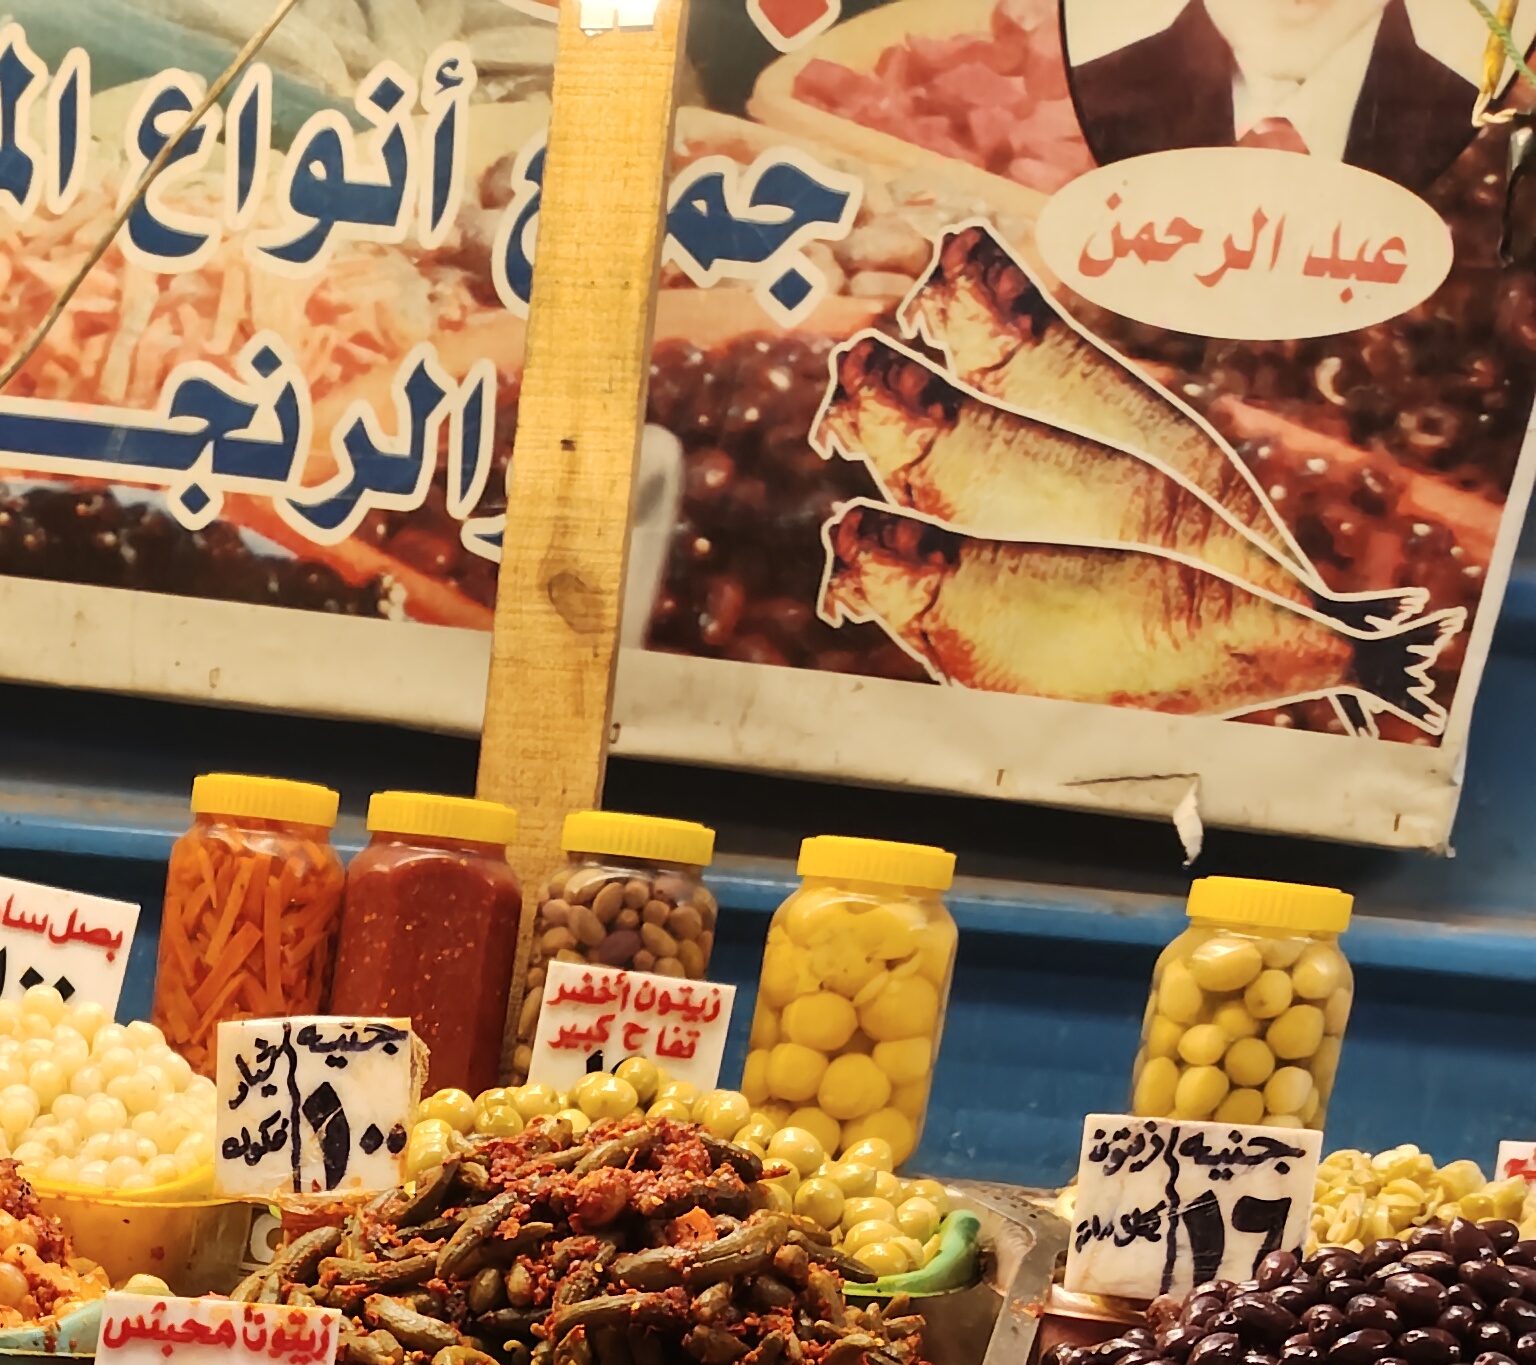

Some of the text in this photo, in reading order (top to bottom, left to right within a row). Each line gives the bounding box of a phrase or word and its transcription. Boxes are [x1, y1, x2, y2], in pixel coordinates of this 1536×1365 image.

[126, 57, 461, 263] أنواع
[505, 145, 851, 311] جمع
[1078, 192, 1398, 304] عبد الرحمن
[49, 907, 124, 963] بصل
[546, 969, 722, 1024] زيتون أخضر
[547, 1013, 616, 1053] كبير
[1178, 1129, 1307, 1181] جنيه
